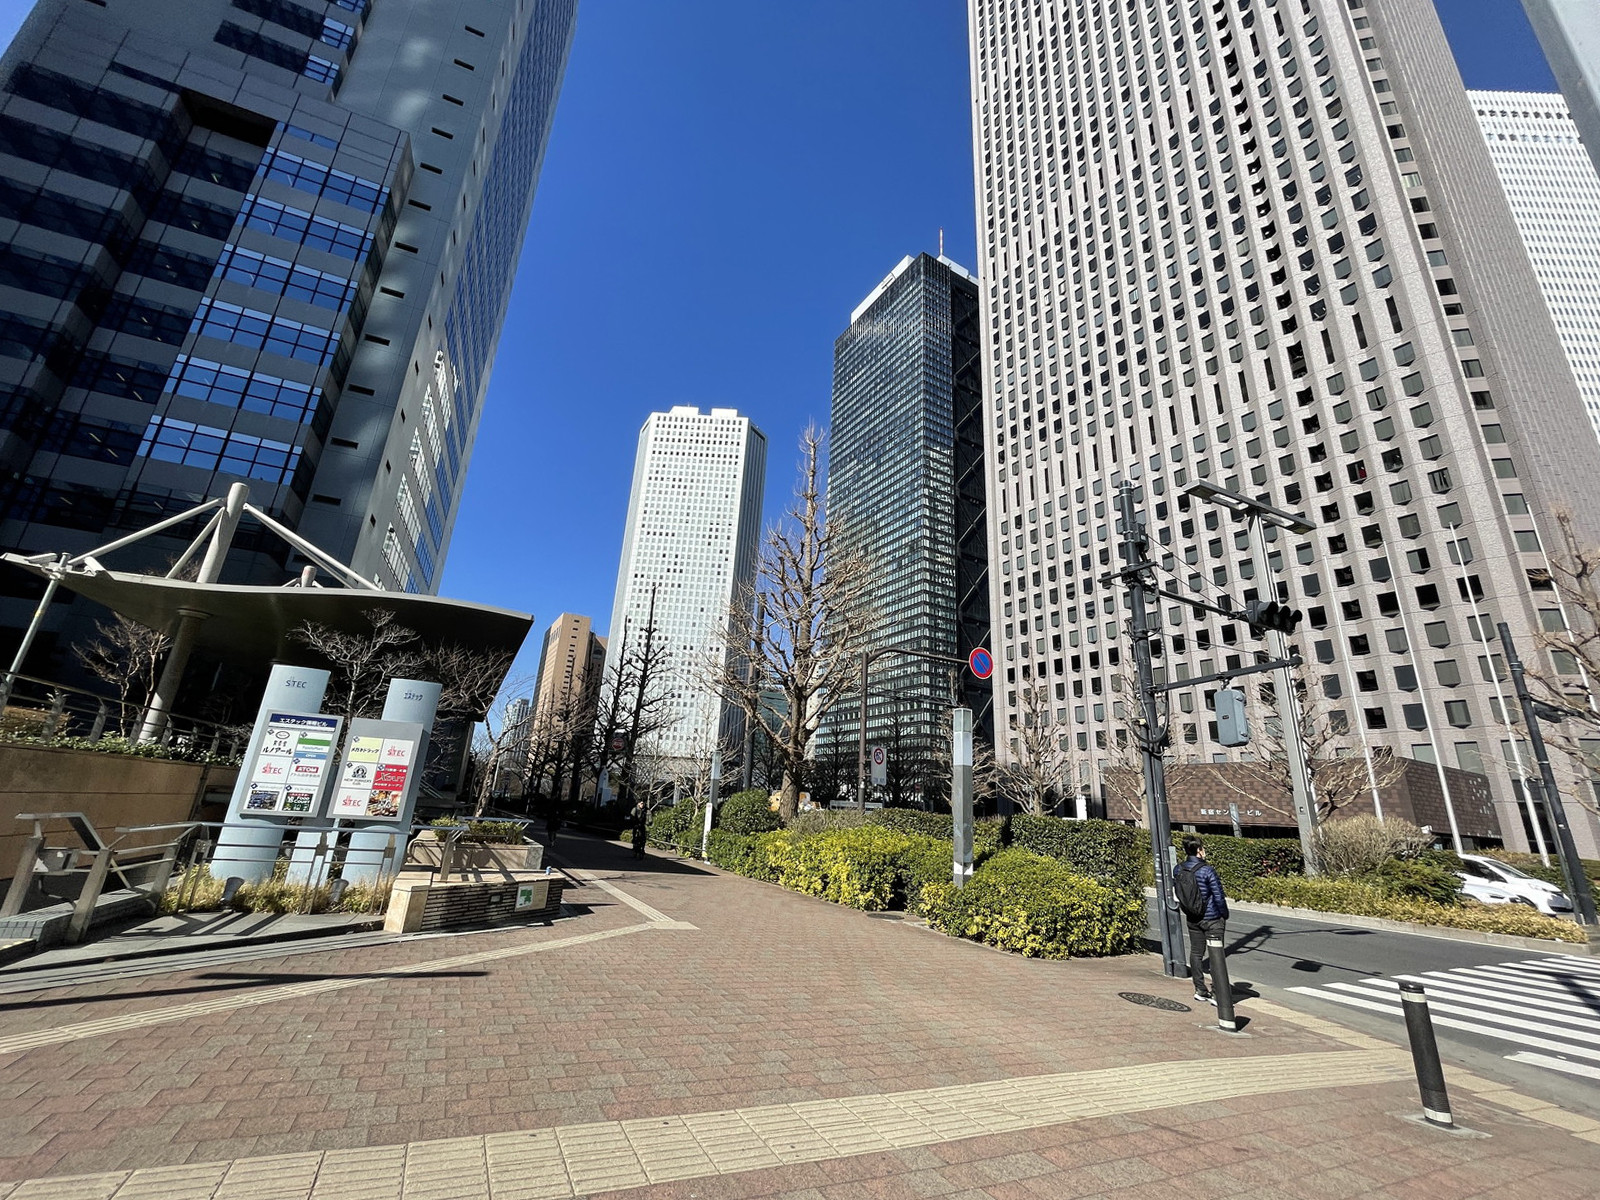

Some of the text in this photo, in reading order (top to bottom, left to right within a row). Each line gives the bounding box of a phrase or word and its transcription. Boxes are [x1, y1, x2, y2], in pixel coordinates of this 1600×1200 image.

[285, 679, 307, 689] STEC
[262, 746, 293, 755] ルノアール
[387, 749, 405, 757] STEC
[262, 767, 283, 775] STEC
[342, 799, 362, 807] STEC
[1200, 808, 1262, 816] 新宿センービル
